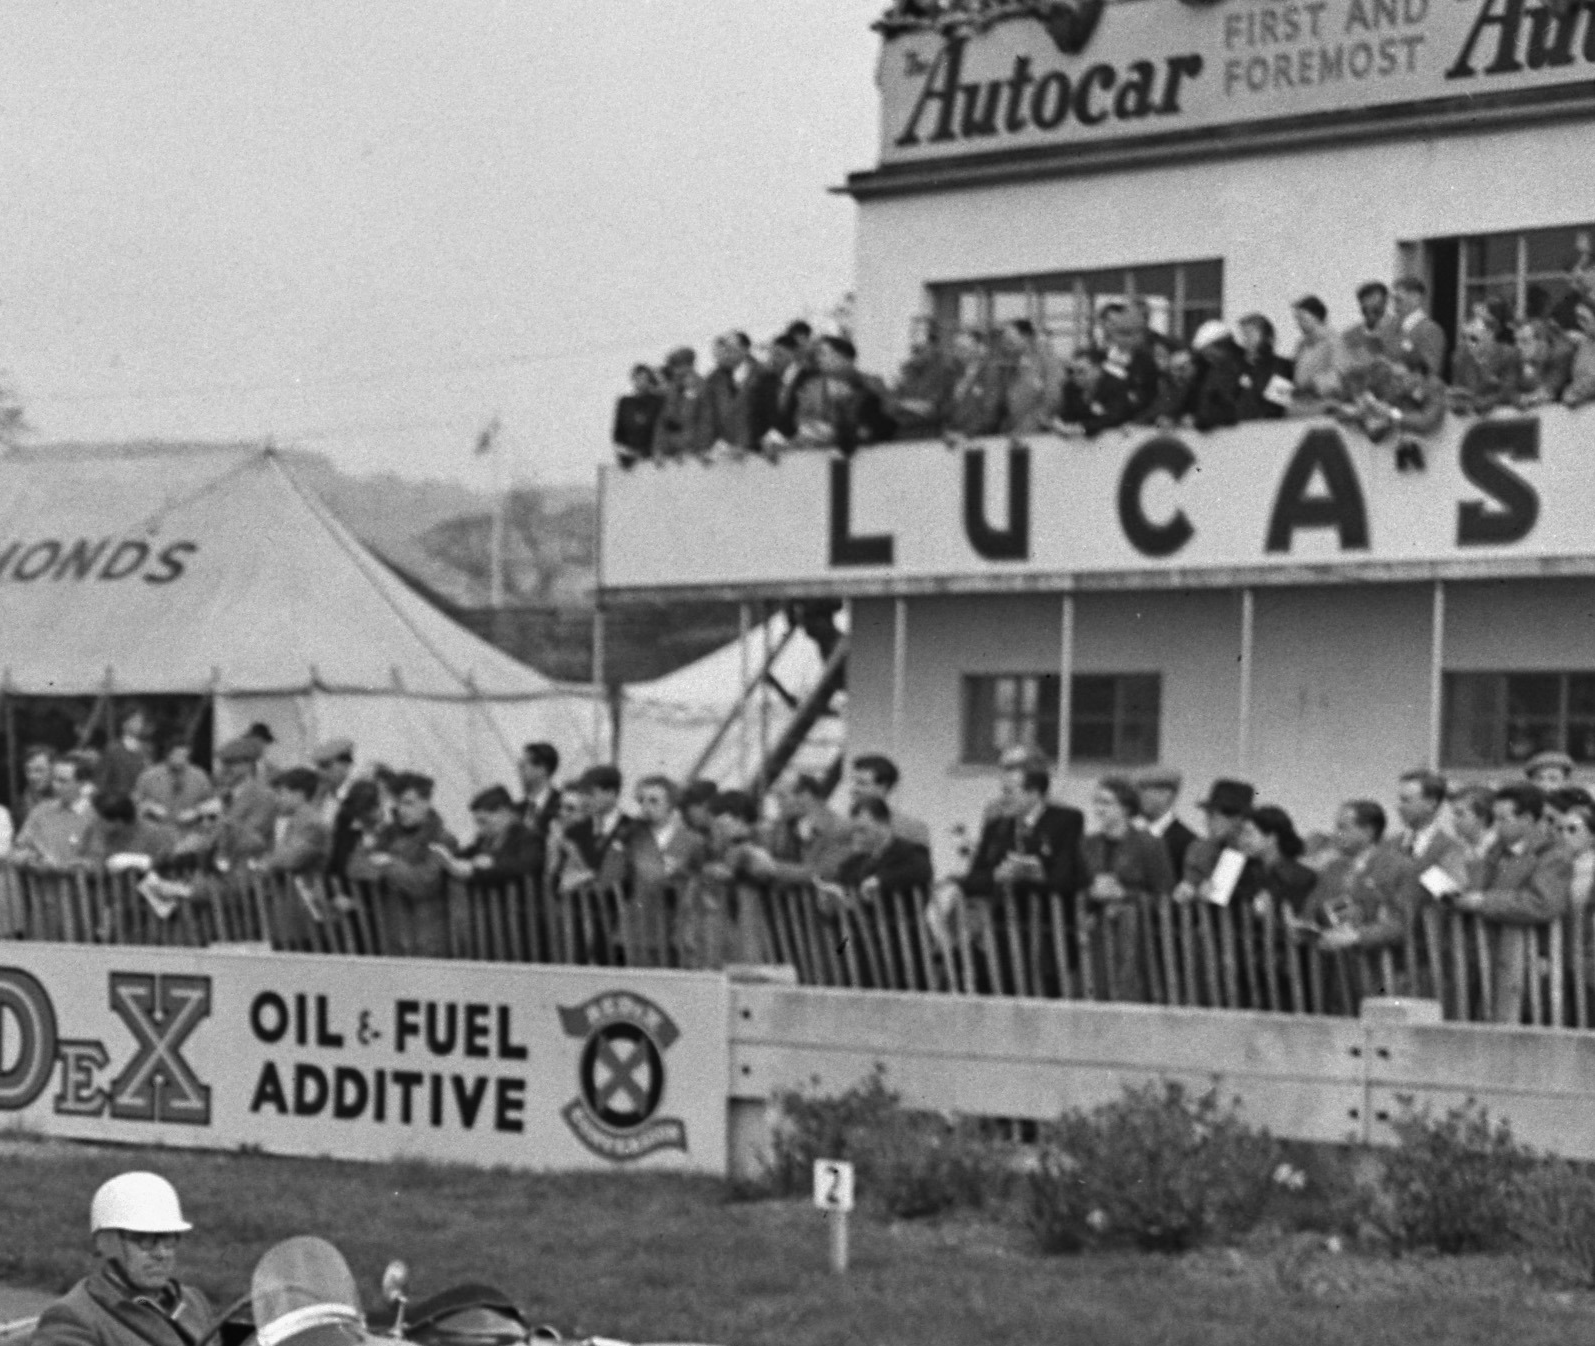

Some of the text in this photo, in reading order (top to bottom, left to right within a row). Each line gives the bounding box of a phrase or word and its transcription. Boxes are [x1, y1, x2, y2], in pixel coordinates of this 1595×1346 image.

[1224, 0, 1430, 49] FIRST AND
[894, 35, 1204, 147] Autocar
[1223, 34, 1425, 97] FOREMOST
[829, 418, 1542, 568] LUCAS
[249, 990, 345, 1049] OIL
[395, 999, 528, 1061] FUEL
[248, 1059, 528, 1134] ADDITIVE
